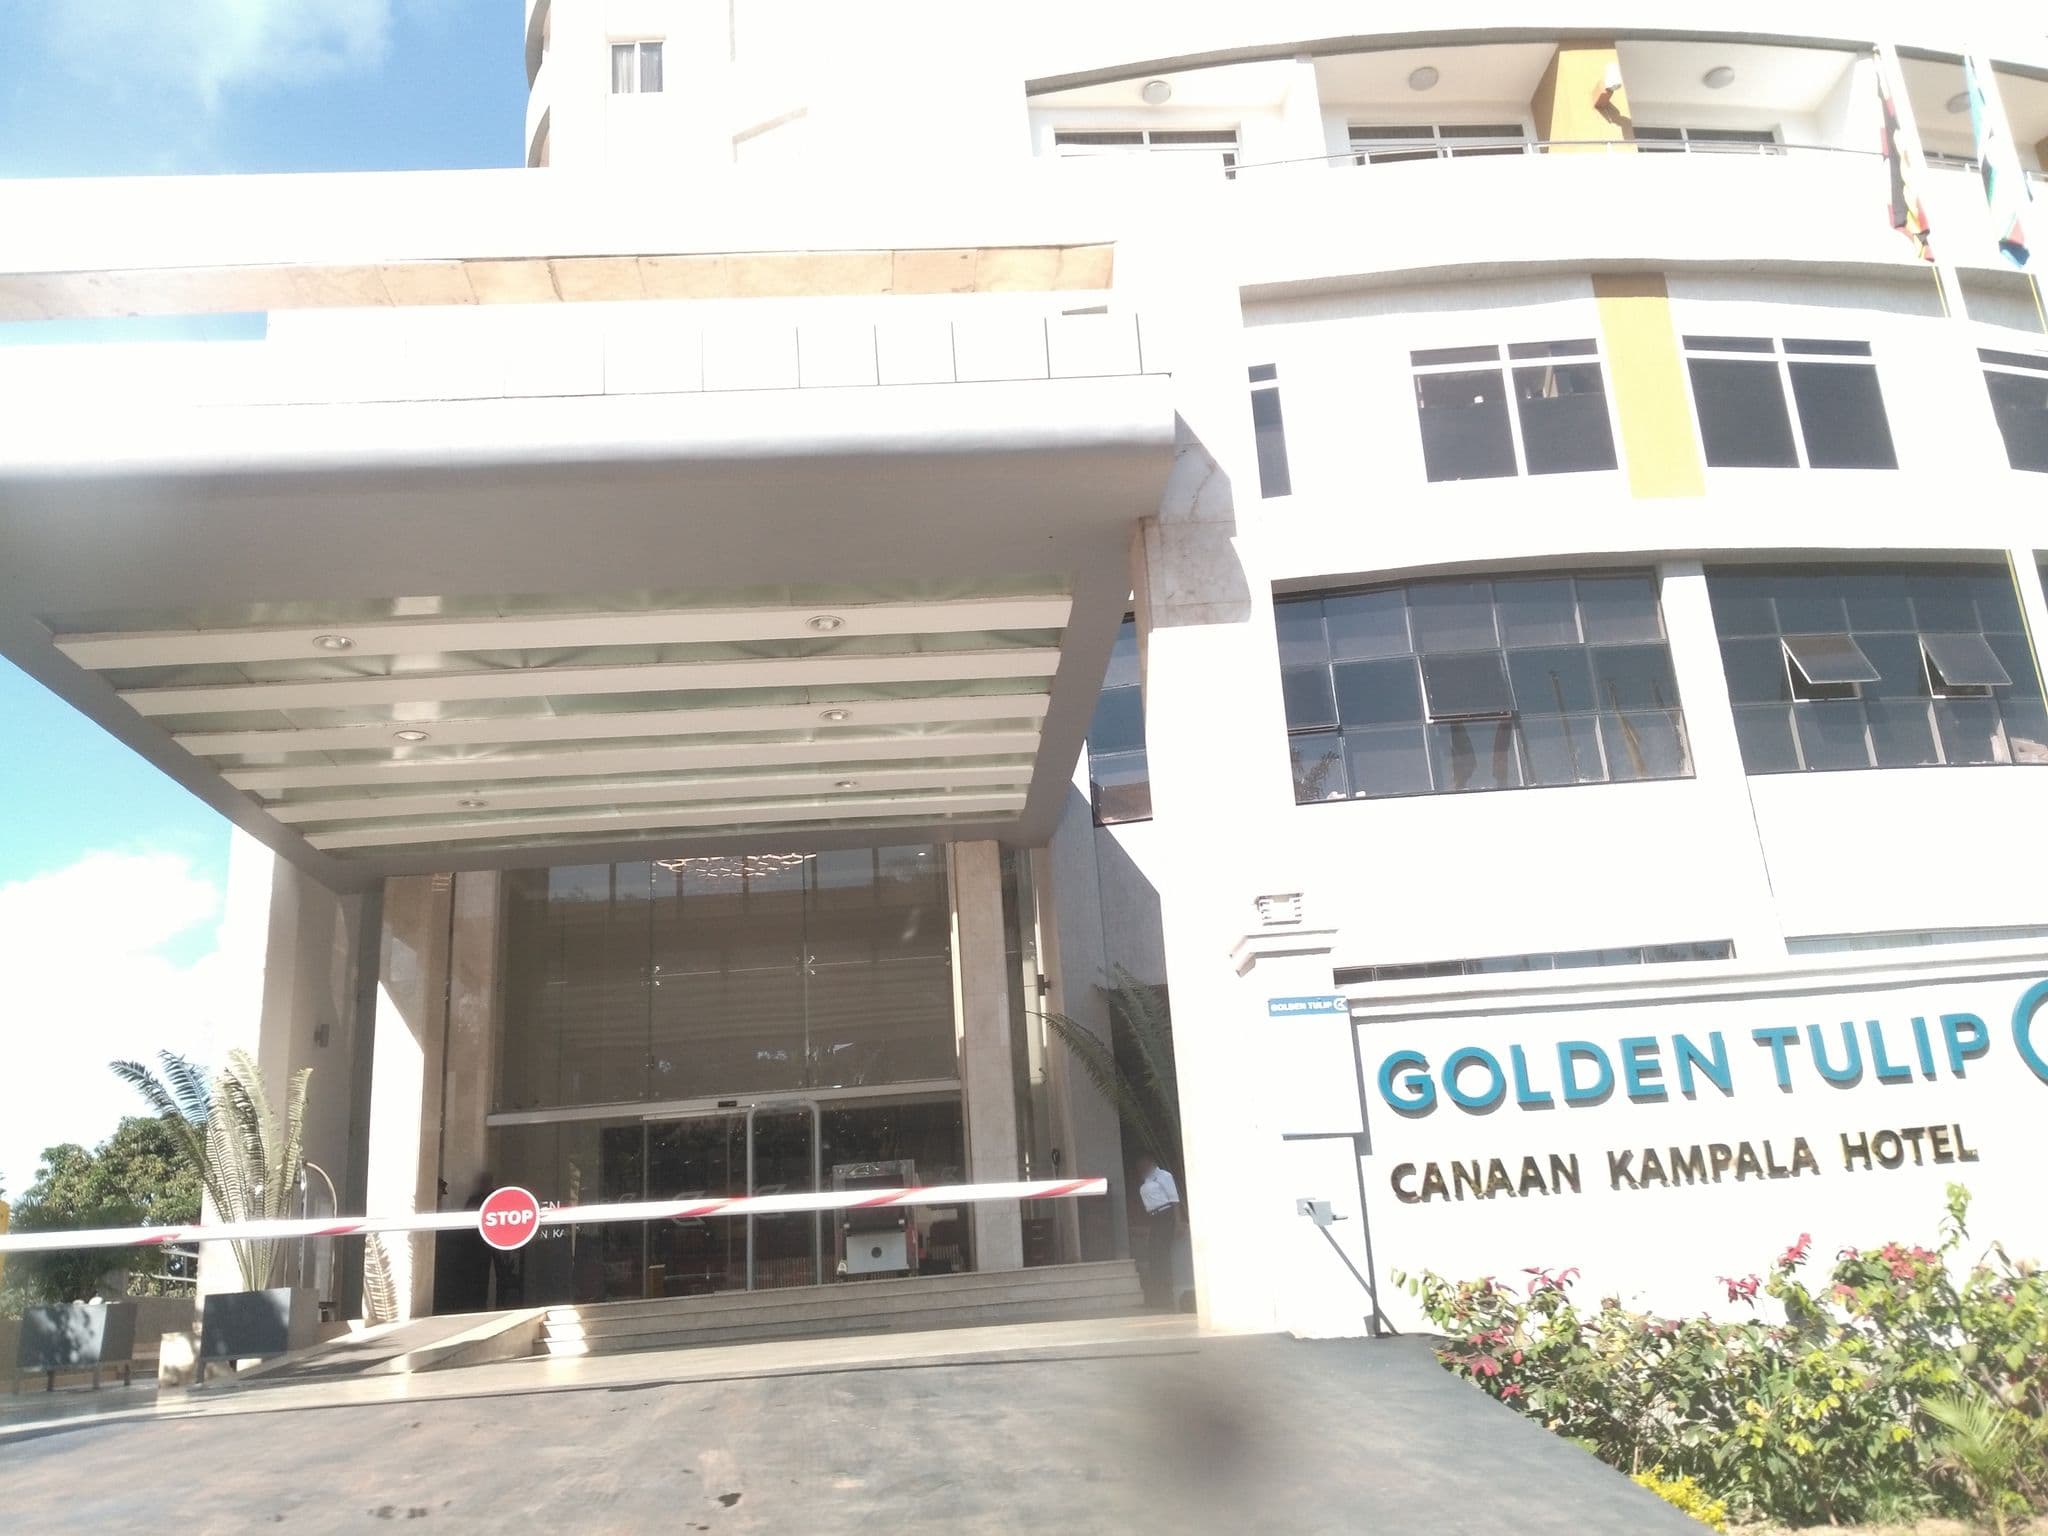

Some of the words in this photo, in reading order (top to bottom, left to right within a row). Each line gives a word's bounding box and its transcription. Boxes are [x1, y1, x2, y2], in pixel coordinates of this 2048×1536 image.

[1377, 1031, 1732, 1114] GOLDEN
[1752, 1012, 1990, 1088] TULIP
[1390, 1153, 1581, 1203] CANAAN
[1607, 1136, 1819, 1190] KAMPALA
[1840, 1123, 1979, 1171] HOTEL
[485, 1210, 533, 1227] STOP
